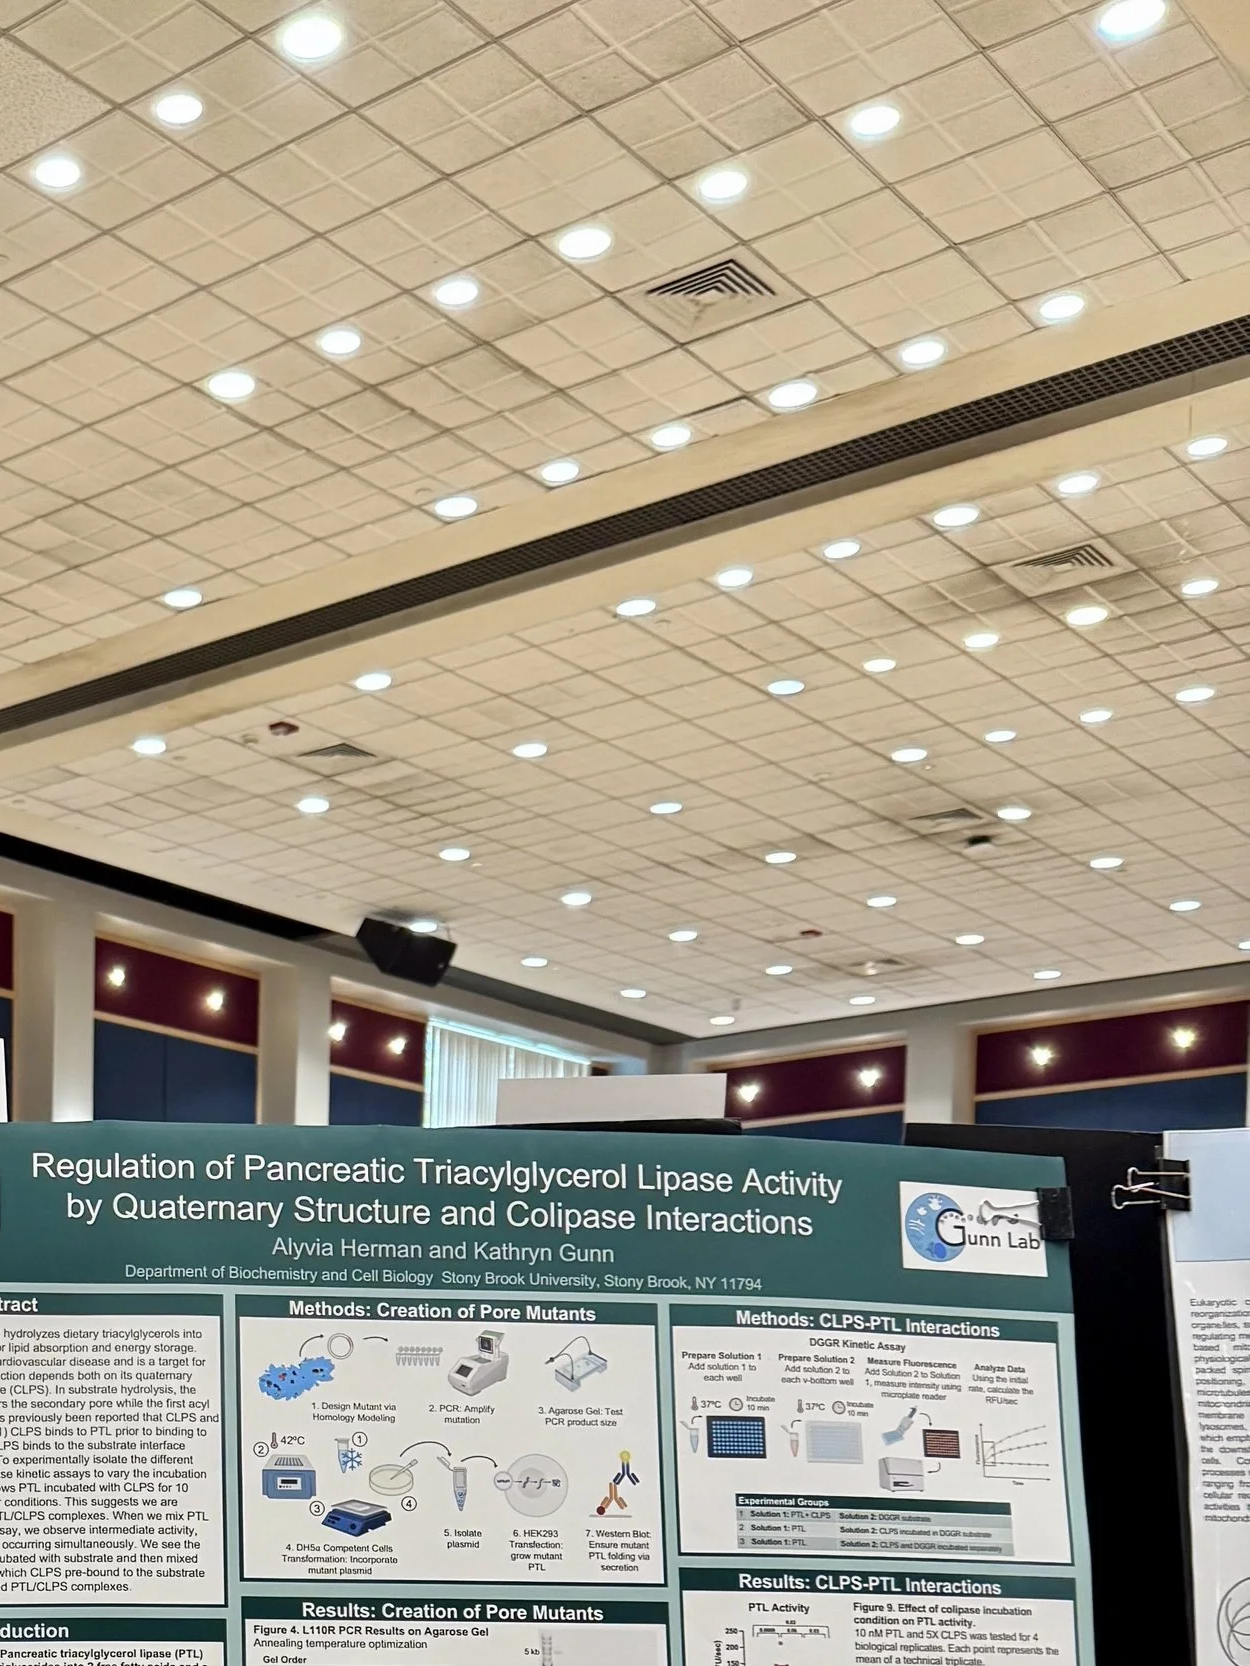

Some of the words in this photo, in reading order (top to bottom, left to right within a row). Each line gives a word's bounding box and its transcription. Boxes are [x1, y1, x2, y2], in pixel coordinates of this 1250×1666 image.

[33, 1152, 194, 1183] Regulation
[206, 1154, 234, 1179] of
[245, 1154, 404, 1184] Pancreatic
[413, 1158, 626, 1193] Triacylglycerol
[638, 1164, 732, 1196] Lipase
[742, 1168, 842, 1203] Activity
[67, 1192, 102, 1224] by
[113, 1193, 283, 1227] Quaternary
[294, 1196, 430, 1223] Structure
[441, 1200, 494, 1225] and
[507, 1201, 634, 1234] Colipase
[647, 1205, 812, 1235] Interactions
[935, 1207, 1002, 1248] Gunn
[1007, 1231, 1041, 1250] Lab
[272, 1237, 333, 1259] Alyvia
[341, 1238, 421, 1257] Herman
[429, 1241, 466, 1258] and
[474, 1241, 551, 1265] Kathryn
[559, 1243, 613, 1261] Gunn
[125, 1264, 207, 1281] Department
[211, 1264, 226, 1278] of
[229, 1265, 318, 1284] Biochemistry
[320, 1269, 346, 1281] and
[352, 1269, 378, 1281] Cell
[383, 1269, 433, 1285] Biology
[442, 1270, 480, 1286] Stony
[485, 1272, 525, 1284] Brook
[530, 1273, 599, 1288] University,
[604, 1274, 643, 1290] Stony
[648, 1275, 690, 1289] Brook,
[695, 1277, 716, 1288] NY
[721, 1277, 763, 1290] 11794
[289, 1301, 370, 1316] Methods:
[377, 1303, 451, 1317] Creation
[457, 1305, 475, 1318] of
[480, 1305, 520, 1318] Pore
[526, 1306, 595, 1320] Mutants
[736, 1311, 813, 1326] Methods:
[819, 1315, 901, 1331] CLPS-PTL
[906, 1319, 999, 1336] Interactions
[4, 1328, 60, 1340] hydrolyzes
[63, 1329, 99, 1340] dietary
[102, 1329, 179, 1340] triacylglycerols
[183, 1329, 202, 1338] into
[809, 1338, 839, 1347] DGGR
[842, 1339, 874, 1349] Kinetic
[877, 1342, 905, 1353] Assay
[681, 1351, 715, 1362] Prepare
[312, 1402, 320, 1412] 1.
[321, 1402, 350, 1414] Design
[354, 1402, 381, 1412] Mutant
[383, 1402, 397, 1412] via
[313, 1413, 354, 1422] Homology
[357, 1414, 395, 1423] Modeling
[11, 1581, 67, 1591] PTL/CLPS
[71, 1581, 130, 1592] complexes.
[739, 1574, 809, 1588] Results:
[815, 1576, 901, 1591] CLPS-PTL
[905, 1578, 1001, 1594] Interactions
[302, 1602, 375, 1617] Results:
[382, 1603, 457, 1618] Creation
[463, 1604, 481, 1618] of
[486, 1604, 526, 1619] Pore
[533, 1605, 603, 1620] Mutants
[748, 1602, 768, 1611] PTL
[771, 1603, 809, 1614] Activity
[853, 1602, 885, 1616] Figure
[886, 1603, 895, 1611] 9.
[898, 1603, 926, 1613] Effect
[928, 1604, 938, 1612] of
[941, 1605, 980, 1615] colipase
[983, 1606, 1031, 1615] incubation
[253, 1625, 286, 1635] Figure
[302, 1626, 335, 1634] L110R
[339, 1626, 361, 1634] PCR
[365, 1626, 404, 1635] Results
[424, 1627, 467, 1637] Agarose
[471, 1627, 488, 1635] Gel
[253, 1638, 302, 1649] Annealing
[306, 1639, 365, 1649] temperature
[368, 1640, 427, 1649] optimization
[263, 1655, 278, 1663] Gel
[281, 1655, 306, 1663] Order
